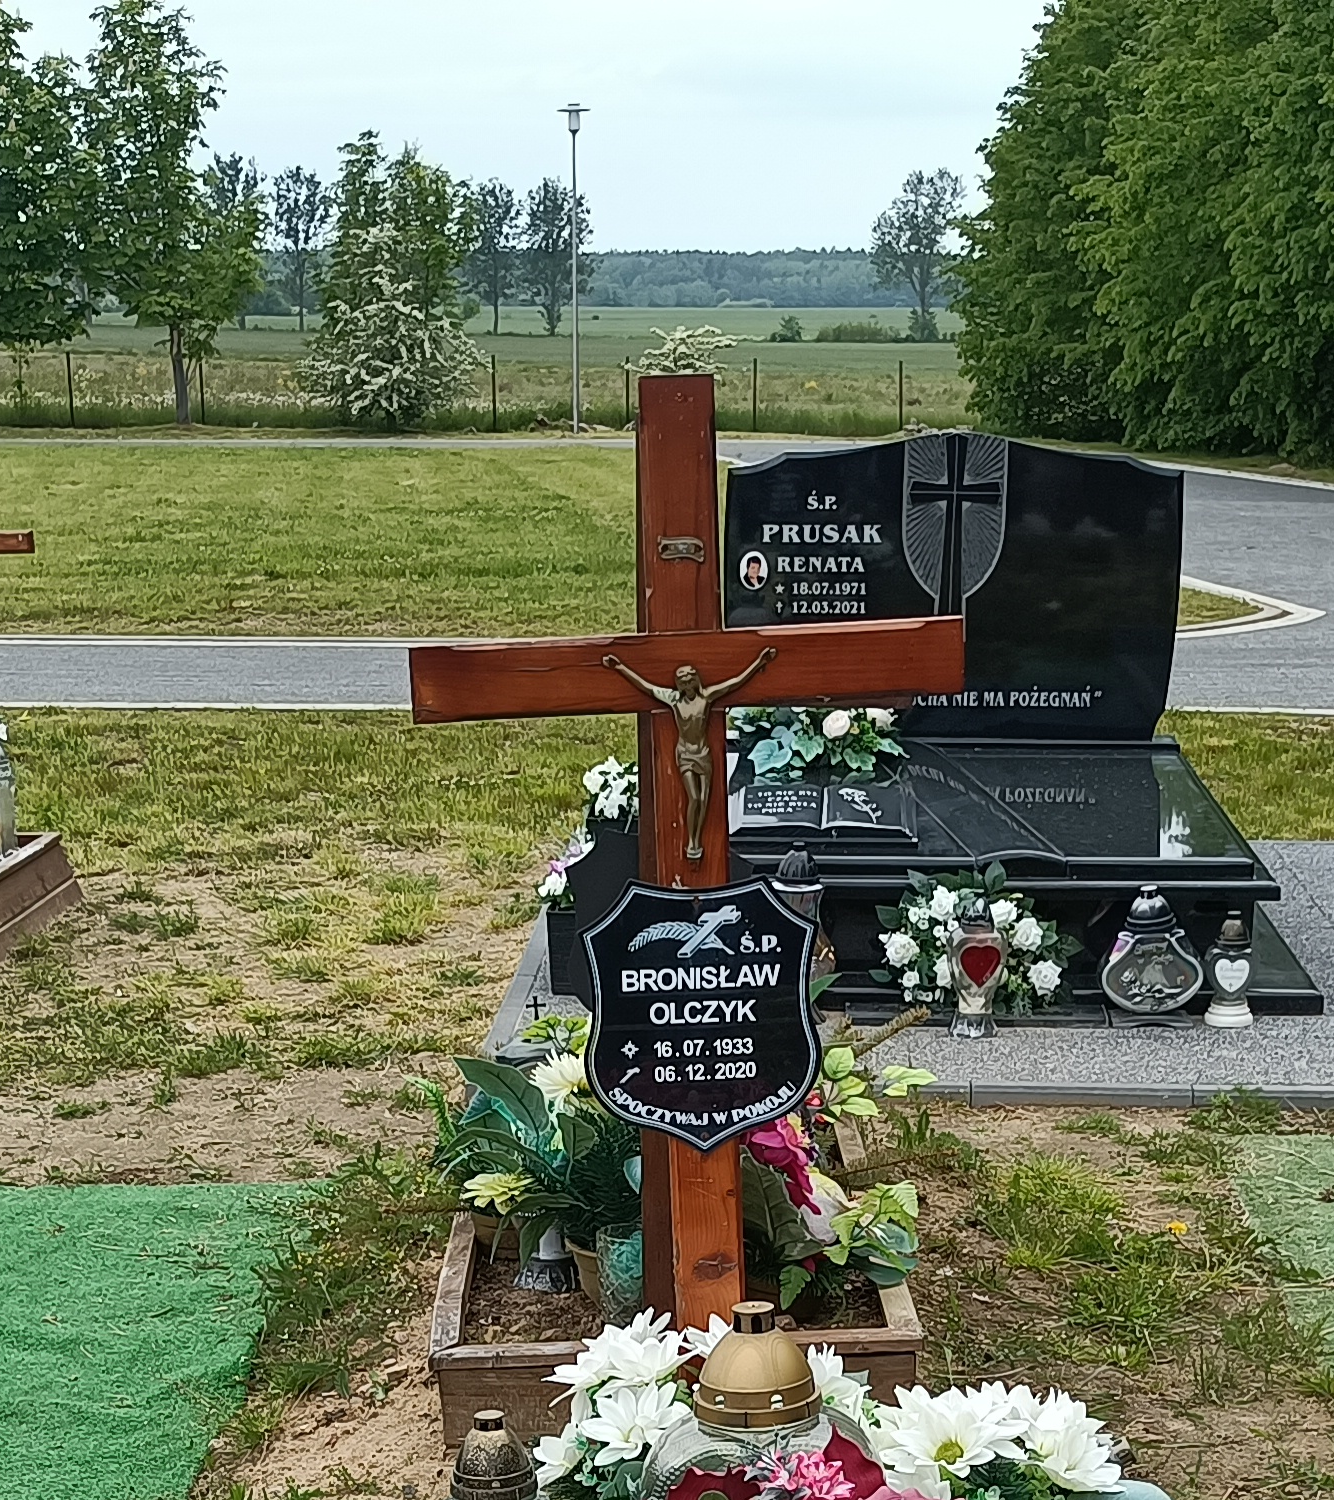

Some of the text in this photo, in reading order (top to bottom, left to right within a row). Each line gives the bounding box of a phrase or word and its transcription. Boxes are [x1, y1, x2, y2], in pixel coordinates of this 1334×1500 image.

[806, 490, 838, 510] Ś.P.
[761, 524, 882, 544] PRUSAK
[777, 556, 865, 573] RENATA
[791, 582, 867, 595] 18.07.1971
[791, 601, 866, 614] 12.03.2021
[953, 691, 979, 706] NIE
[983, 691, 1005, 706] MA
[739, 931, 782, 953] Ś.P.
[620, 964, 781, 993] BRONISŁAW
[649, 999, 757, 1025] OLCZYK
[608, 1080, 797, 1126] SPOCZYWAJ W POKOJU
